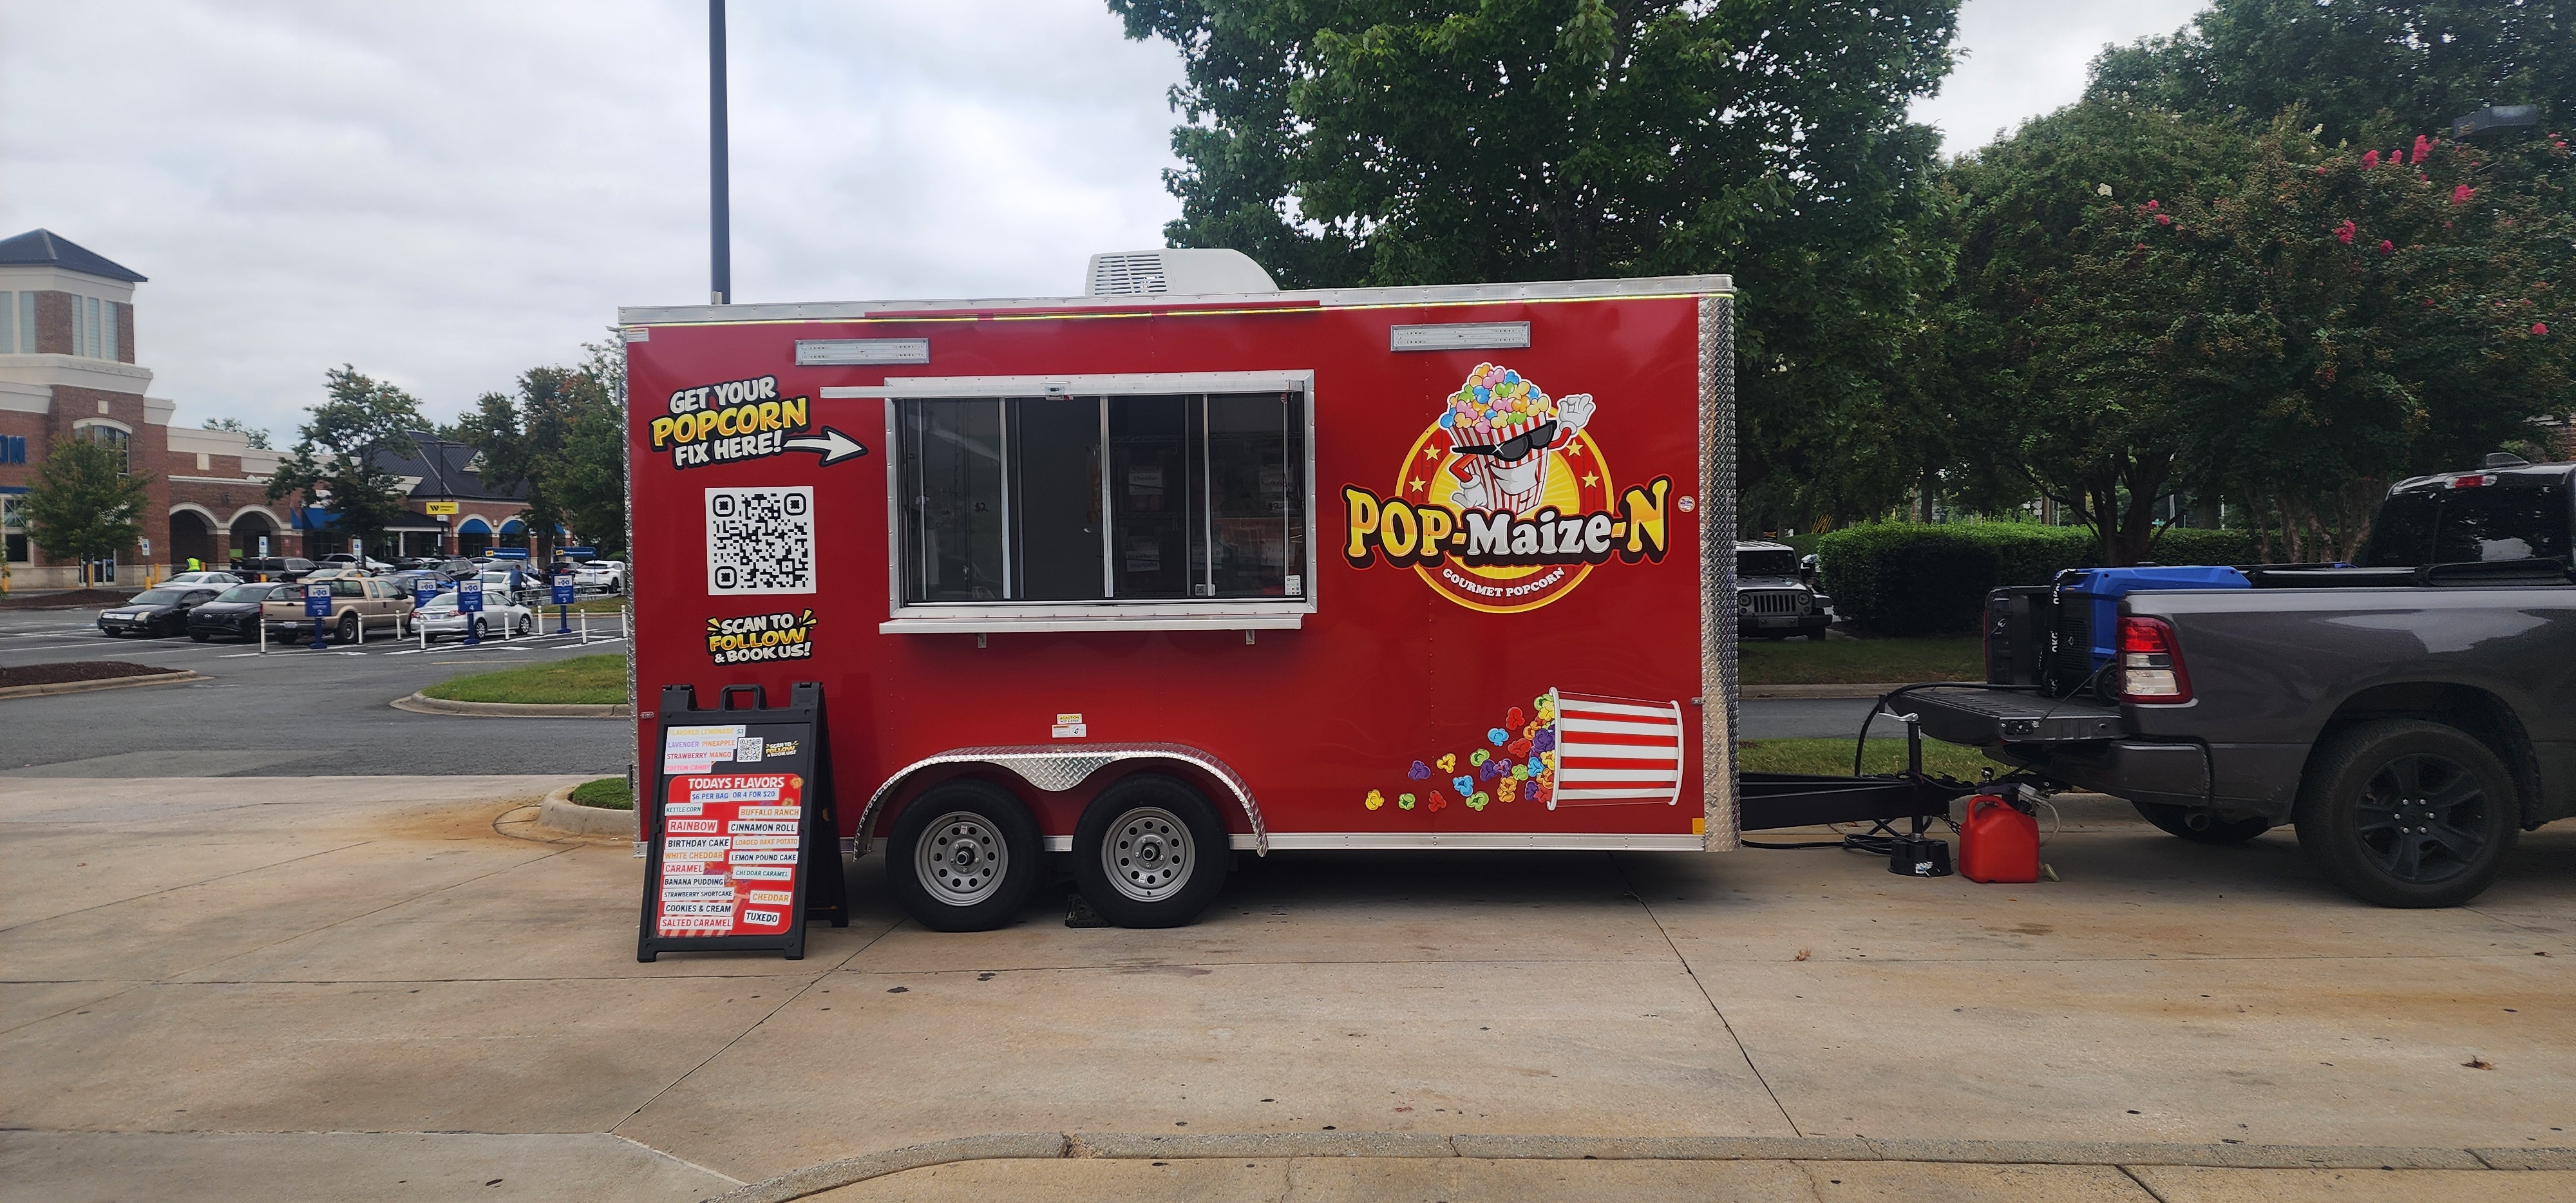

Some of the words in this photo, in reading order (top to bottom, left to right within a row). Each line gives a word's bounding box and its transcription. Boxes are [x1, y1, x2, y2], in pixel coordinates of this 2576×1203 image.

[670, 387, 709, 414] GET
[714, 376, 775, 406] YOUR
[651, 397, 807, 446] POPCORN
[674, 445, 710, 466] FIX
[714, 430, 784, 460] HERE!
[974, 502, 989, 512] $2
[1443, 567, 1502, 598] GOURMET
[1506, 567, 1565, 598] POPCORN
[721, 616, 766, 634] SCAN
[770, 613, 794, 629] TO
[709, 627, 806, 652] FOLLOW
[715, 653, 726, 664] &
[726, 647, 777, 663] BOOK
[778, 641, 811, 658] US!
[688, 777, 732, 790] TODAYS
[734, 777, 785, 788] FLAVORS
[670, 821, 717, 831] RAINBOW
[668, 839, 707, 848] BIRTHDAY
[708, 838, 729, 847] CAKE
[694, 918, 732, 927] CARAMEL
[746, 912, 778, 923] TUXEDO
